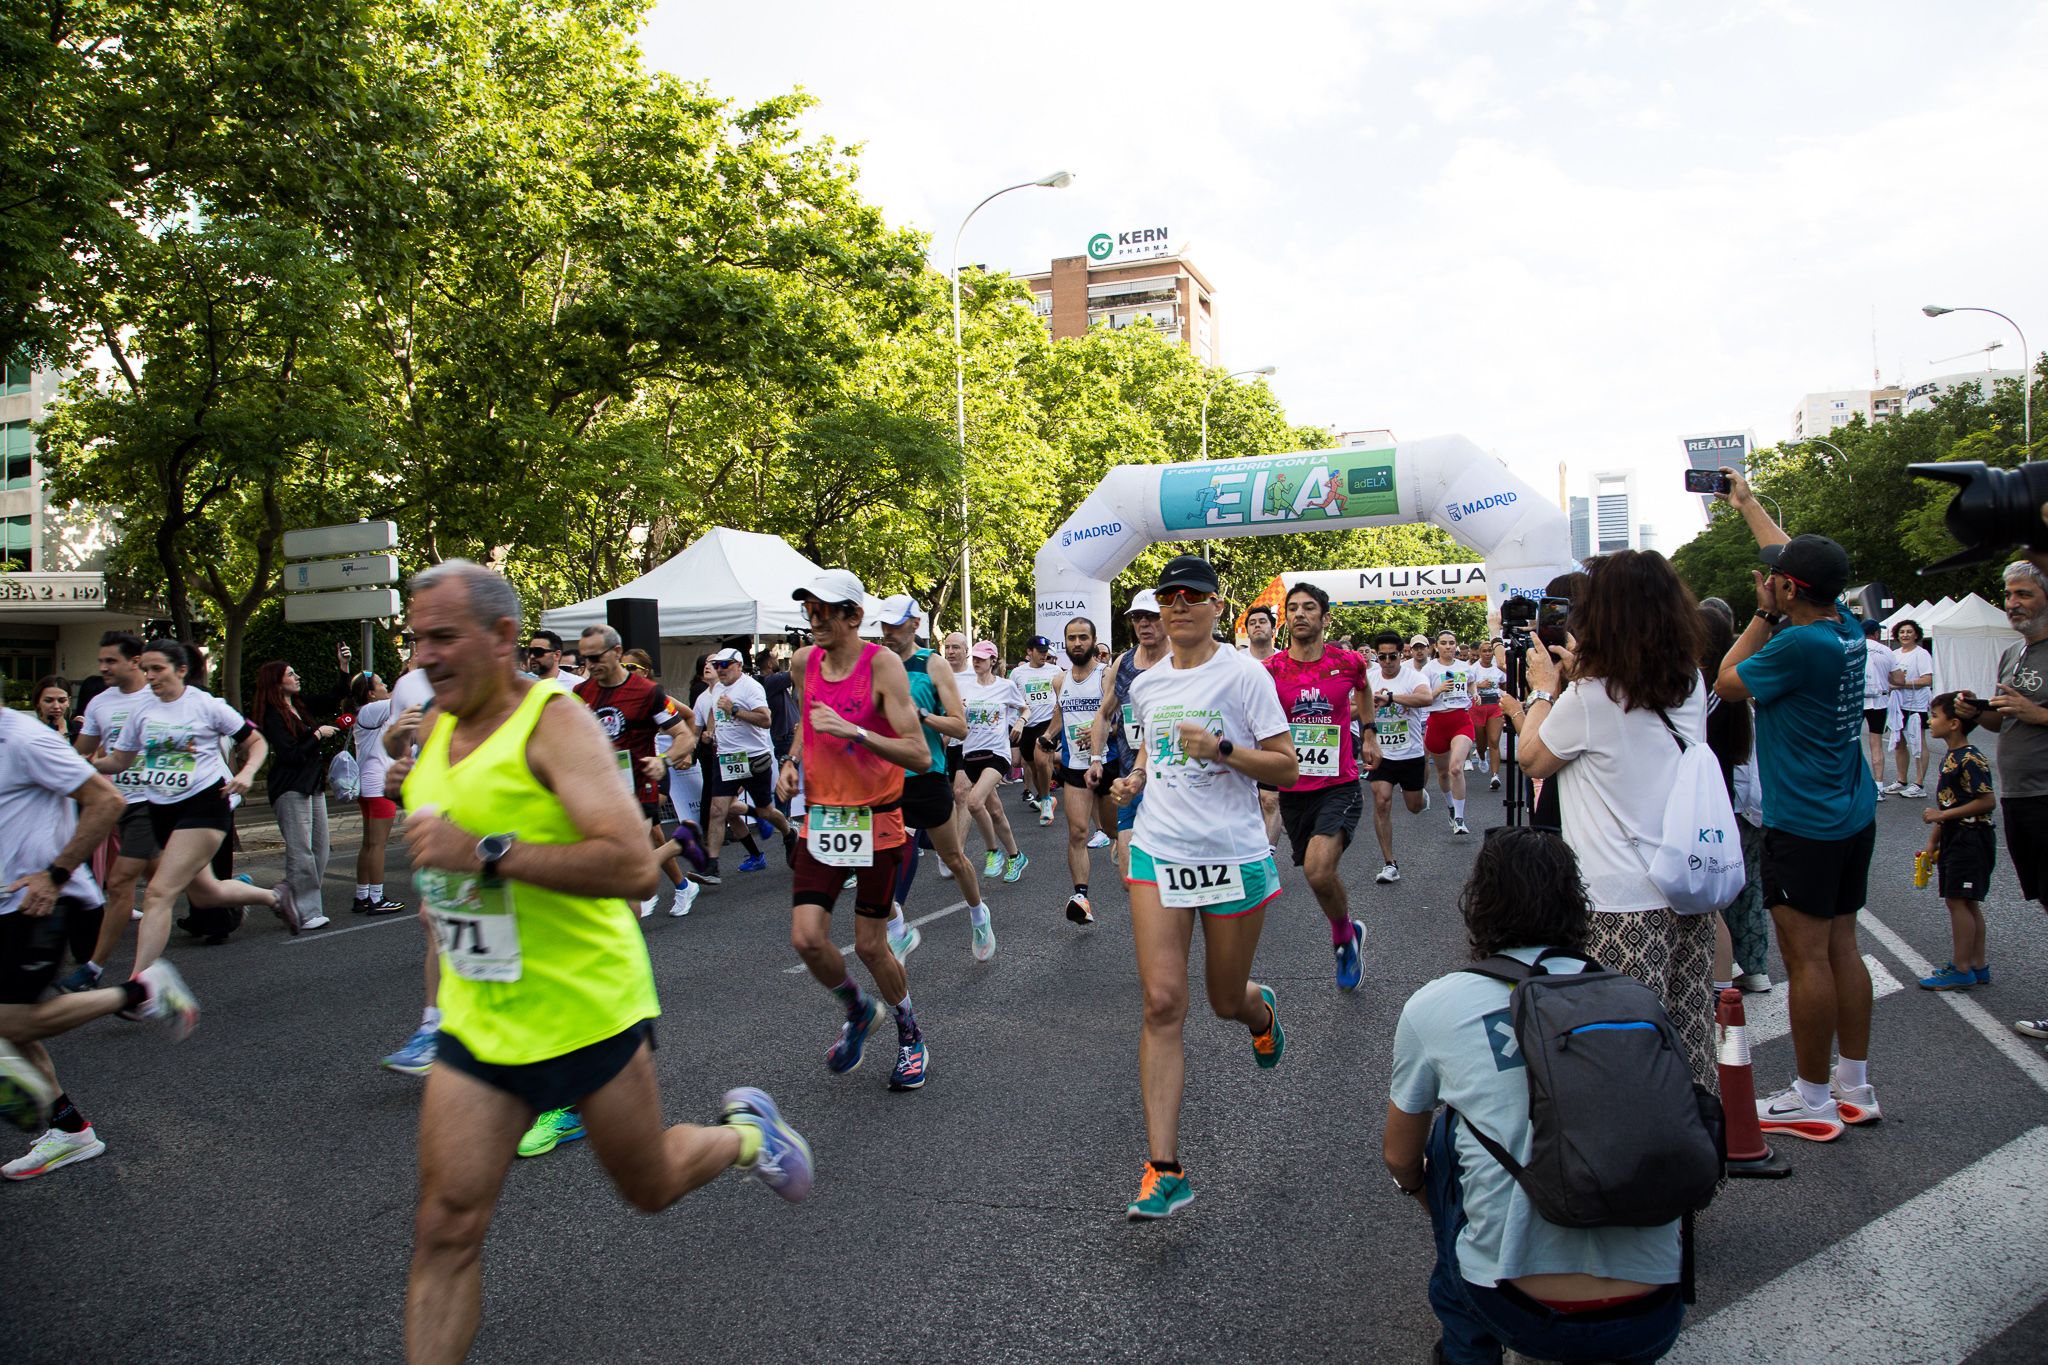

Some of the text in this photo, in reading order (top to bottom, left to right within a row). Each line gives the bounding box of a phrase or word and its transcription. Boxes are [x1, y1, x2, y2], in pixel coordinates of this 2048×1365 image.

[1119, 227, 1168, 245] KERN
[1119, 244, 1168, 255] PHARMA
[1688, 438, 1741, 451] REALIA
[1214, 461, 1272, 473] MADRID
[1274, 458, 1303, 468] CON
[1309, 456, 1329, 465] LA
[1206, 465, 1343, 525] ELA
[1462, 491, 1518, 516] MADRID
[1074, 522, 1122, 542] MADRID
[1360, 567, 1487, 589] MUKUA
[40, 585, 53, 600] 2
[72, 586, 100, 600] 149
[1421, 588, 1456, 596] COLOURS
[1510, 587, 1547, 600] Bioge
[1038, 600, 1086, 611] MUKUA
[1030, 692, 1048, 701] 503
[1153, 711, 1184, 719] MADRID
[1186, 710, 1207, 718] CON
[1308, 716, 1332, 724] LUNES
[1294, 729, 1328, 744] ELA
[1379, 733, 1406, 745] 1225
[726, 764, 745, 774] 981
[142, 771, 188, 787] 1068
[822, 812, 859, 828] ELA
[818, 833, 863, 853] 509
[1165, 864, 1231, 891] 1012
[442, 917, 490, 955] 71
